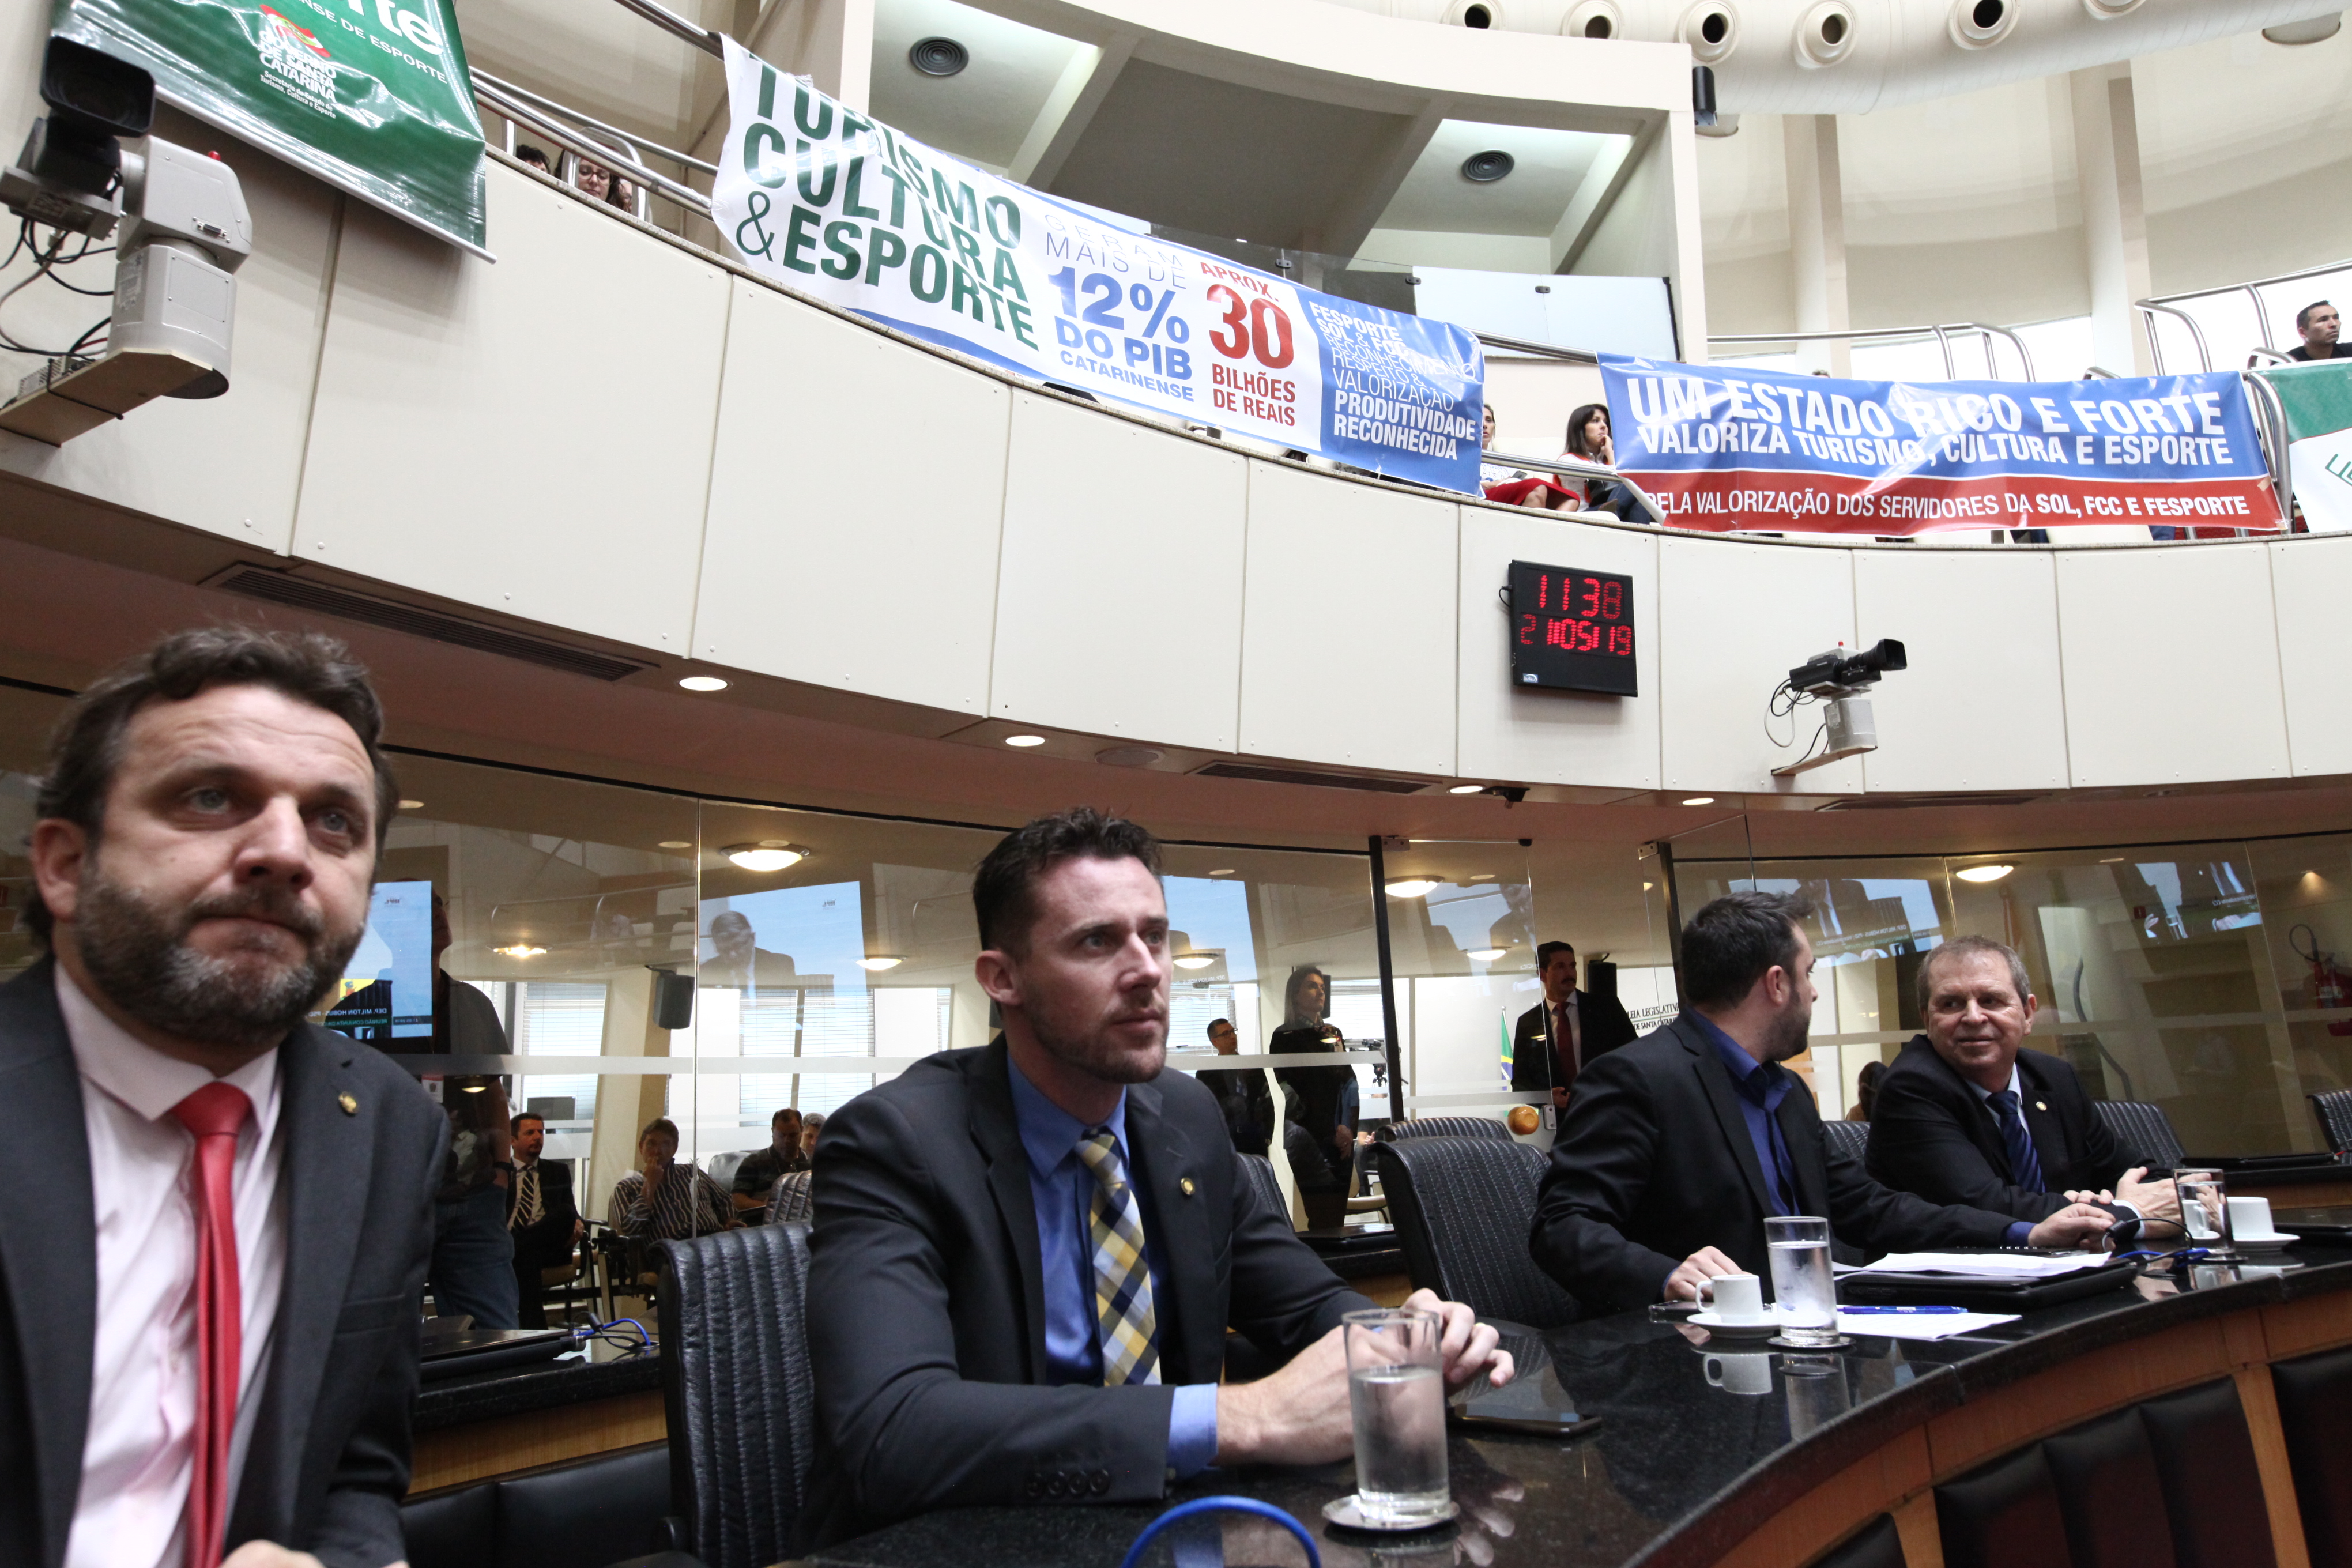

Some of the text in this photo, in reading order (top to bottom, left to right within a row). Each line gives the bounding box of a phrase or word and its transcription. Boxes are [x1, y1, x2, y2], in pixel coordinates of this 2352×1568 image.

[259, 40, 336, 92] DE SANTA
[341, 18, 366, 39] DE
[370, 35, 447, 84] ESPORTE
[259, 52, 338, 104] CATARINA
[260, 74, 286, 94] Turismo,
[287, 88, 308, 105] Cultura
[314, 103, 337, 119] Esporte
[264, 70, 296, 92] Secretaria
[325, 103, 333, 111] de
[743, 122, 1028, 302] CULTURA
[1045, 214, 1183, 267] GERAM
[1046, 232, 1186, 289] MAIS DE
[736, 190, 1039, 352] & ESPORTE
[1200, 262, 1279, 303] APROX.
[1048, 266, 1190, 344] 12%
[1206, 284, 1295, 370] 30
[1309, 301, 1403, 341] FESPORTE
[1054, 316, 1193, 380] DO PIB
[1316, 318, 1409, 358] SOL & FCC
[1322, 332, 1476, 379] RECONHECIMENTO
[1060, 350, 1194, 402] CATARINENSE
[1212, 364, 1296, 404] BILHÕES
[1331, 346, 1427, 388] RESPEITO &
[1332, 367, 1454, 412] VALORIZAÇÃO
[1213, 388, 1296, 427] DE REAIS
[1335, 389, 1476, 442] PRODUTIVIDADE
[1627, 378, 2225, 439] UM ESTADO RICO E FORTE
[1333, 413, 1457, 461] RECONHECIDA
[1636, 423, 2233, 467] VALORIZA TURISMO, CULTURA E ESPORTE
[1696, 488, 1829, 519] VALORIZAÇÃO
[1836, 493, 1875, 516] DOS
[1879, 494, 2000, 519] SERVIDORES
[2005, 493, 2034, 514] DA
[2037, 493, 2082, 519] SOL,
[2083, 495, 2123, 517] FCC
[2125, 498, 2142, 517] E
[2147, 496, 2250, 517] FESPORTE
[1641, 1020, 1657, 1030] SANTA
